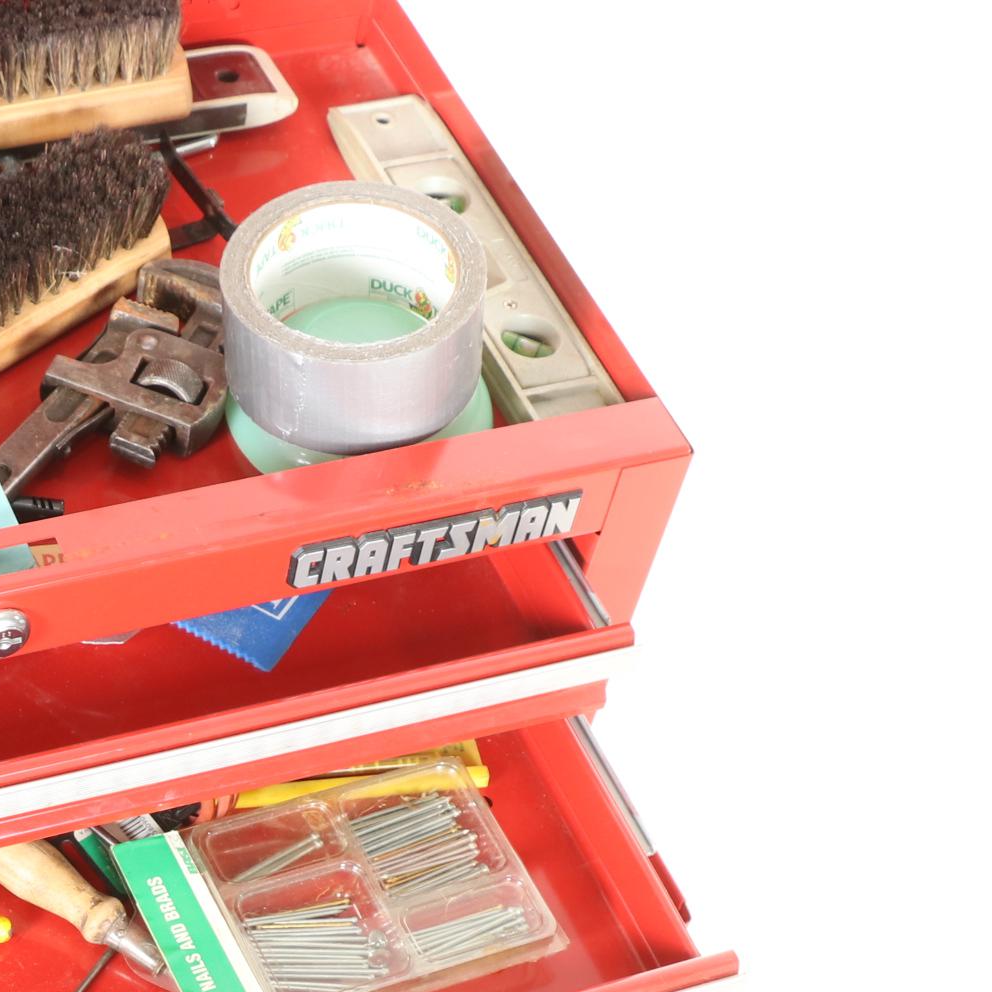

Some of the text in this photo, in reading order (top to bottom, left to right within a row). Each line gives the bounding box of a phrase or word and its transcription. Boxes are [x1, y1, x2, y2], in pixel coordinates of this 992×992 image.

[370, 278, 413, 299] DUCK
[288, 490, 583, 589] CRAFTSMAN
[146, 876, 180, 922] BRADS
[170, 923, 196, 951] AND
[185, 953, 216, 992] NAILS
